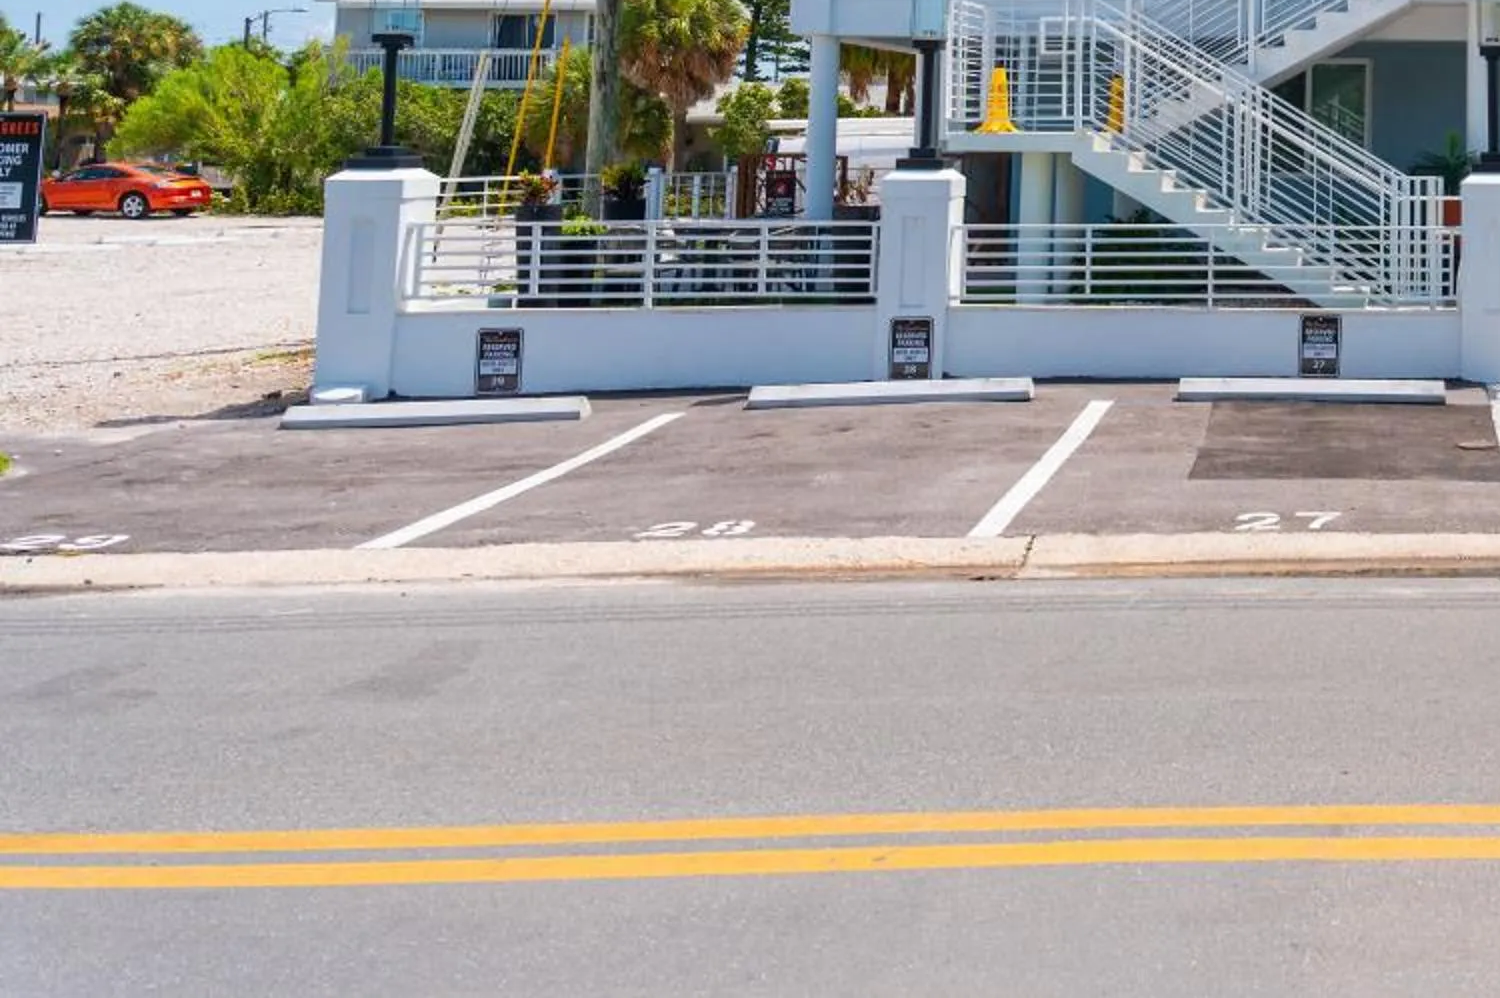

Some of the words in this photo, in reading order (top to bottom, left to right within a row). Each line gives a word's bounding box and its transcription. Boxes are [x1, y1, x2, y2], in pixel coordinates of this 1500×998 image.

[1311, 359, 1326, 370] 27
[632, 520, 756, 537] 28
[1234, 511, 1342, 531] 27
[0, 534, 130, 550] 29
